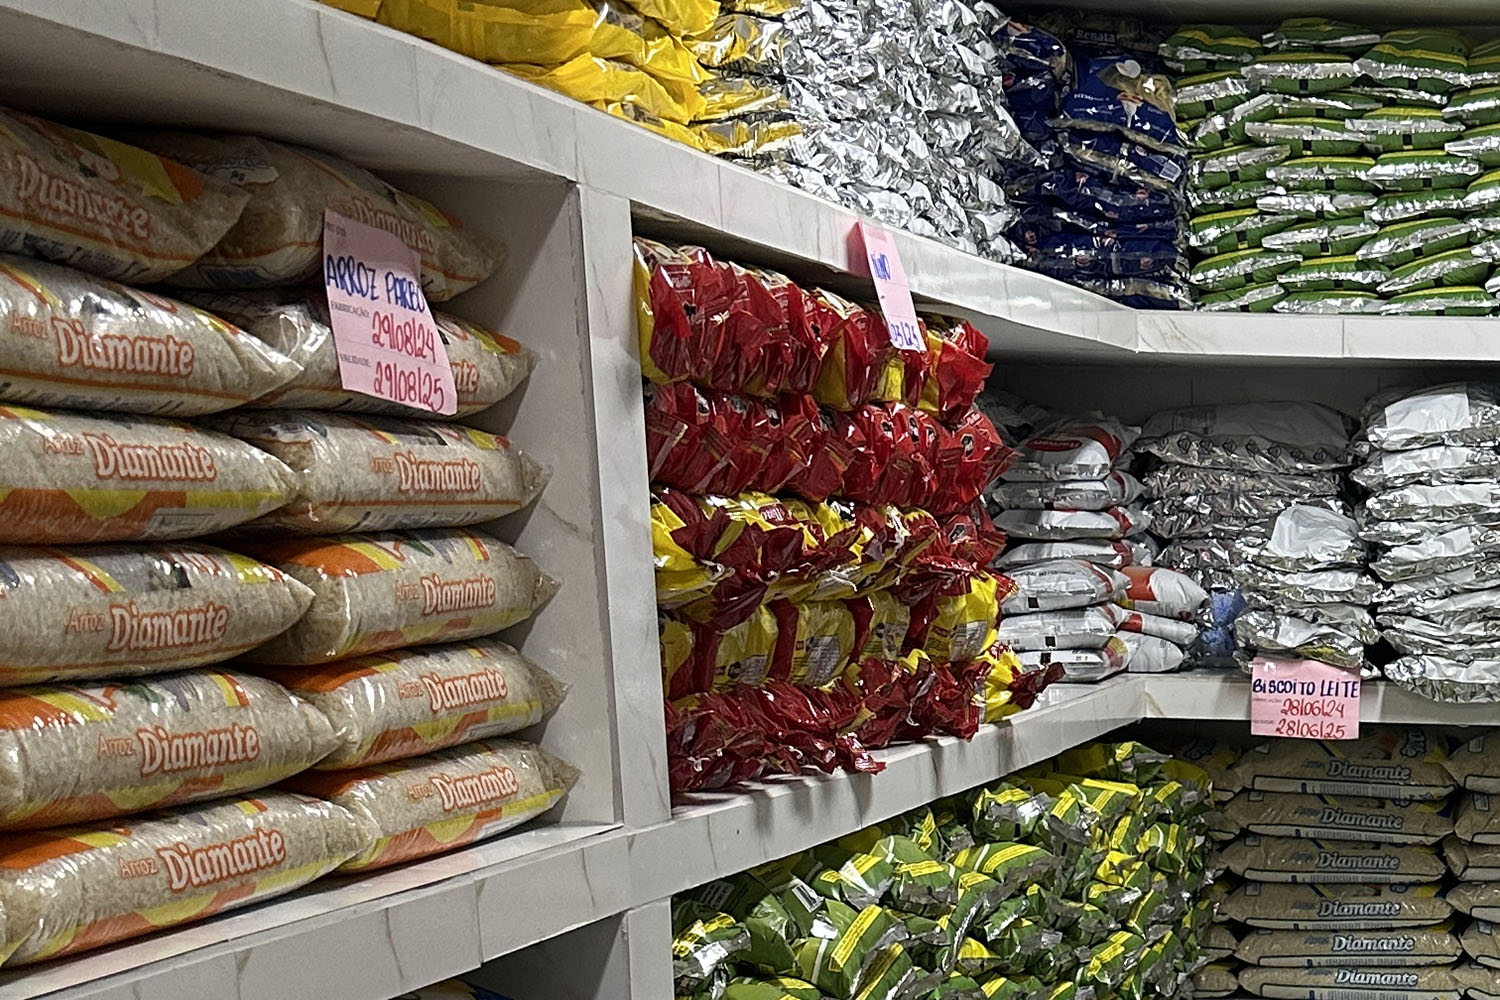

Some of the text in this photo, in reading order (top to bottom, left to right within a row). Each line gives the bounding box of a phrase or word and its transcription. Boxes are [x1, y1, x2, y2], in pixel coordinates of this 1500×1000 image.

[1075, 29, 1116, 42] Renata
[326, 253, 380, 301] ARROZ
[10, 311, 196, 377] Arroz Diamante
[371, 310, 437, 364] 29/08/24
[373, 360, 446, 415] 29/08/25
[82, 431, 218, 481] Diamante
[394, 449, 482, 494] Diamante
[420, 571, 497, 618] Diamante
[65, 599, 231, 653] Arroz Diamante
[419, 667, 508, 714] Diamante
[1252, 678, 1359, 698] BISCOITO LEITE
[98, 722, 262, 777] Arroz Diamante
[1328, 760, 1411, 780] Diamante
[428, 764, 519, 813] Diamante
[1321, 808, 1404, 829] Diamante
[117, 826, 287, 894] Arroz Diamante
[1316, 852, 1400, 870] Diamante
[1317, 900, 1402, 917] Diamante
[1332, 935, 1416, 952] Diamante
[1335, 967, 1419, 986] Diamante
